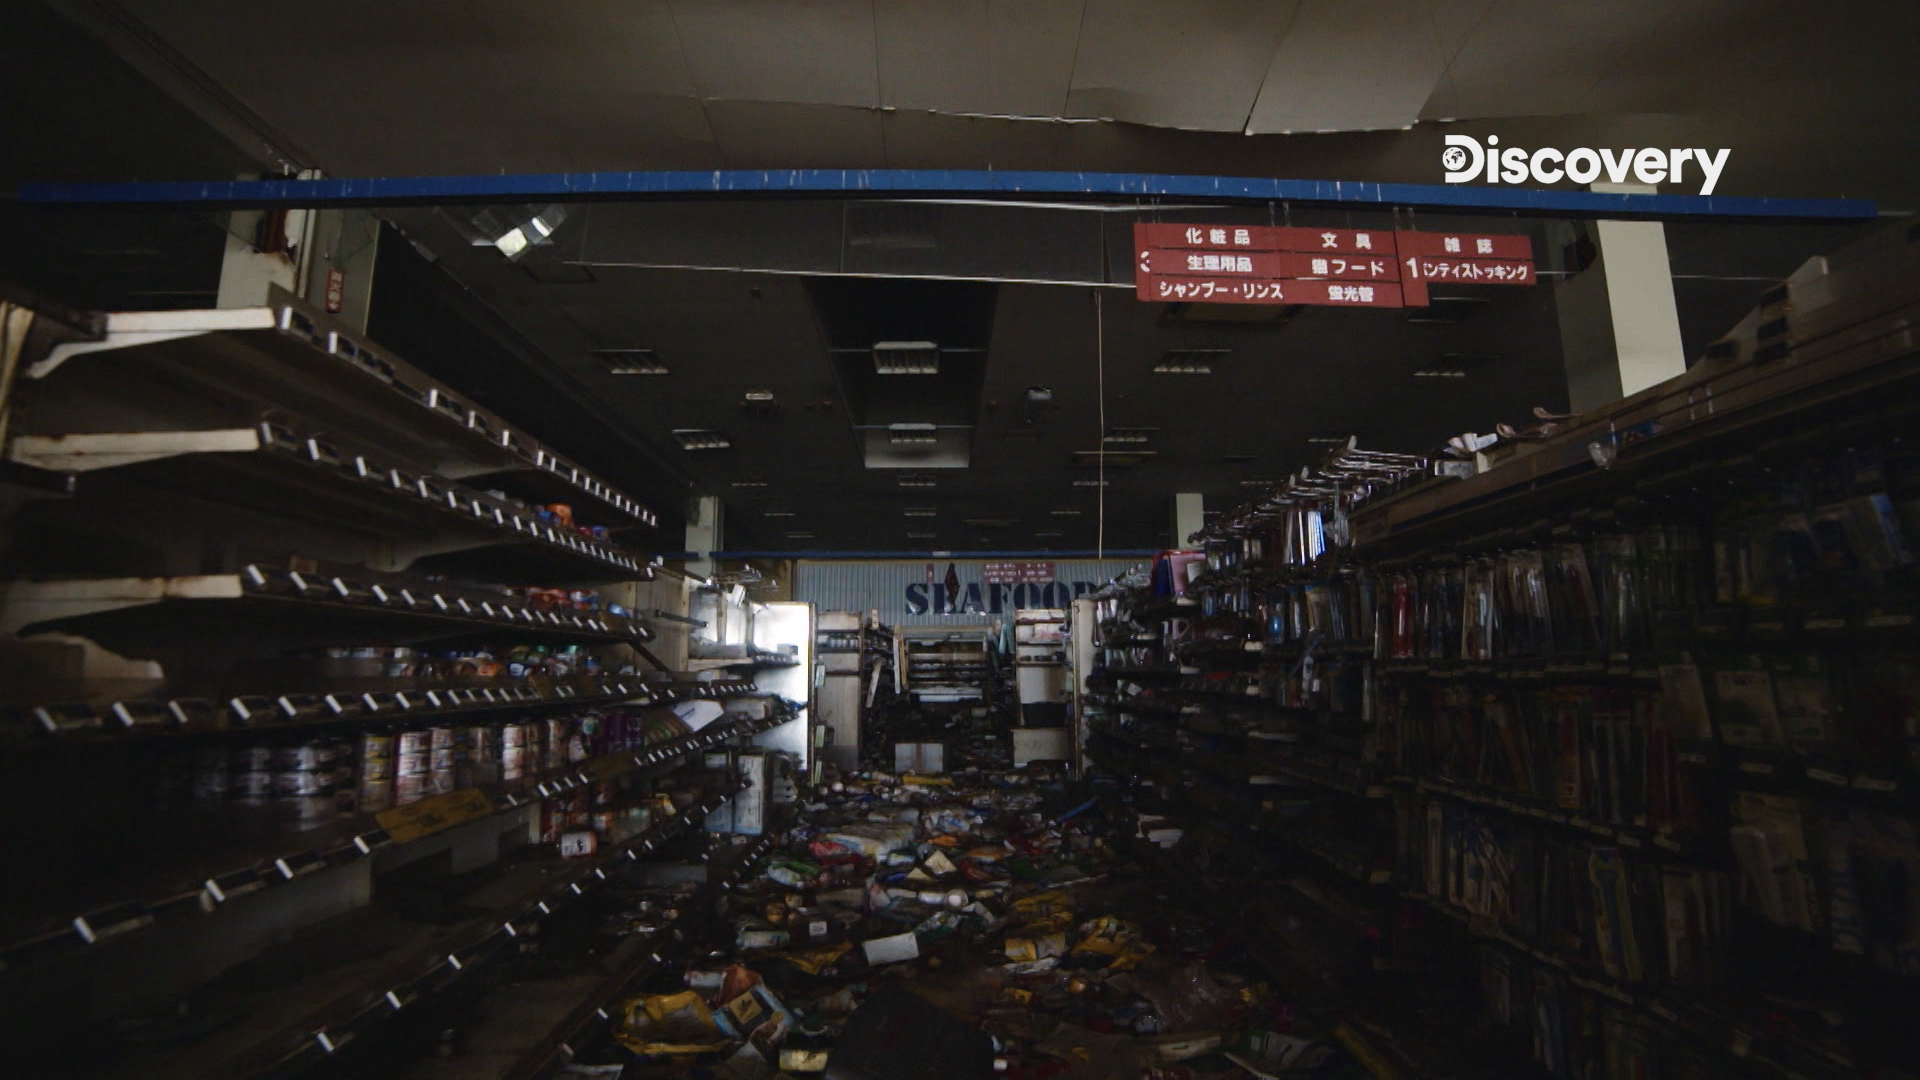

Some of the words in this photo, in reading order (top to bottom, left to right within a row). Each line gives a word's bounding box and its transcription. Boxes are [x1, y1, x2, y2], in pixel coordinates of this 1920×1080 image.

[1185, 227, 1251, 246] 化粧品
[1320, 231, 1372, 250] 文具
[1186, 254, 1253, 273] 生理用品
[1406, 257, 1419, 279] 1
